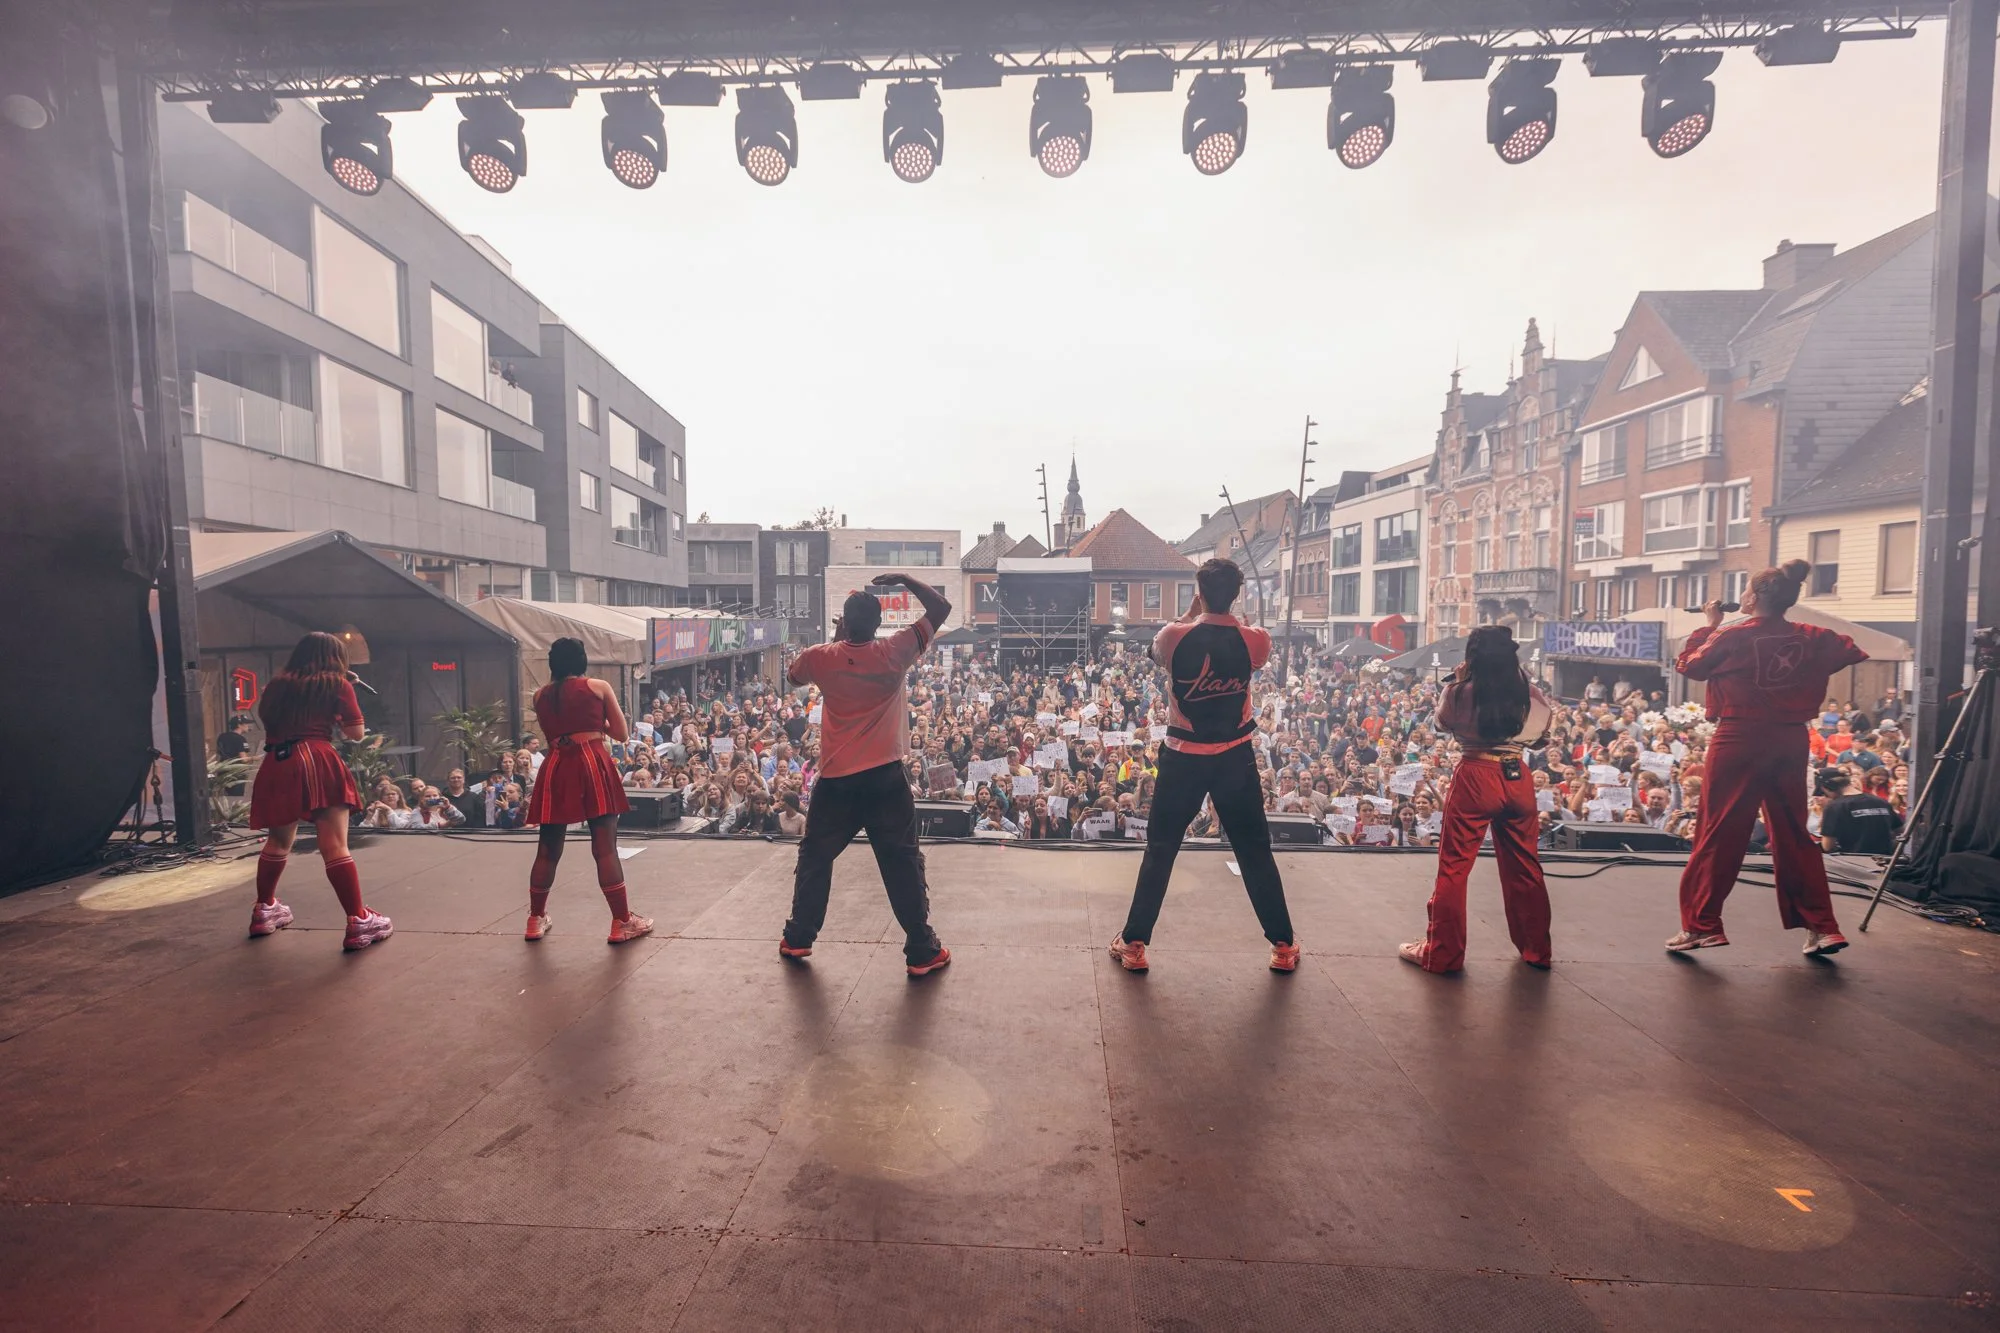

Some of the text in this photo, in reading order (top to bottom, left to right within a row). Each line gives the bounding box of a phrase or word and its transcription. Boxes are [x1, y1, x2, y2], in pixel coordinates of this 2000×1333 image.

[675, 631, 695, 650] DRANK
[1575, 632, 1616, 648] DRANK
[1177, 652, 1247, 701] Liam
